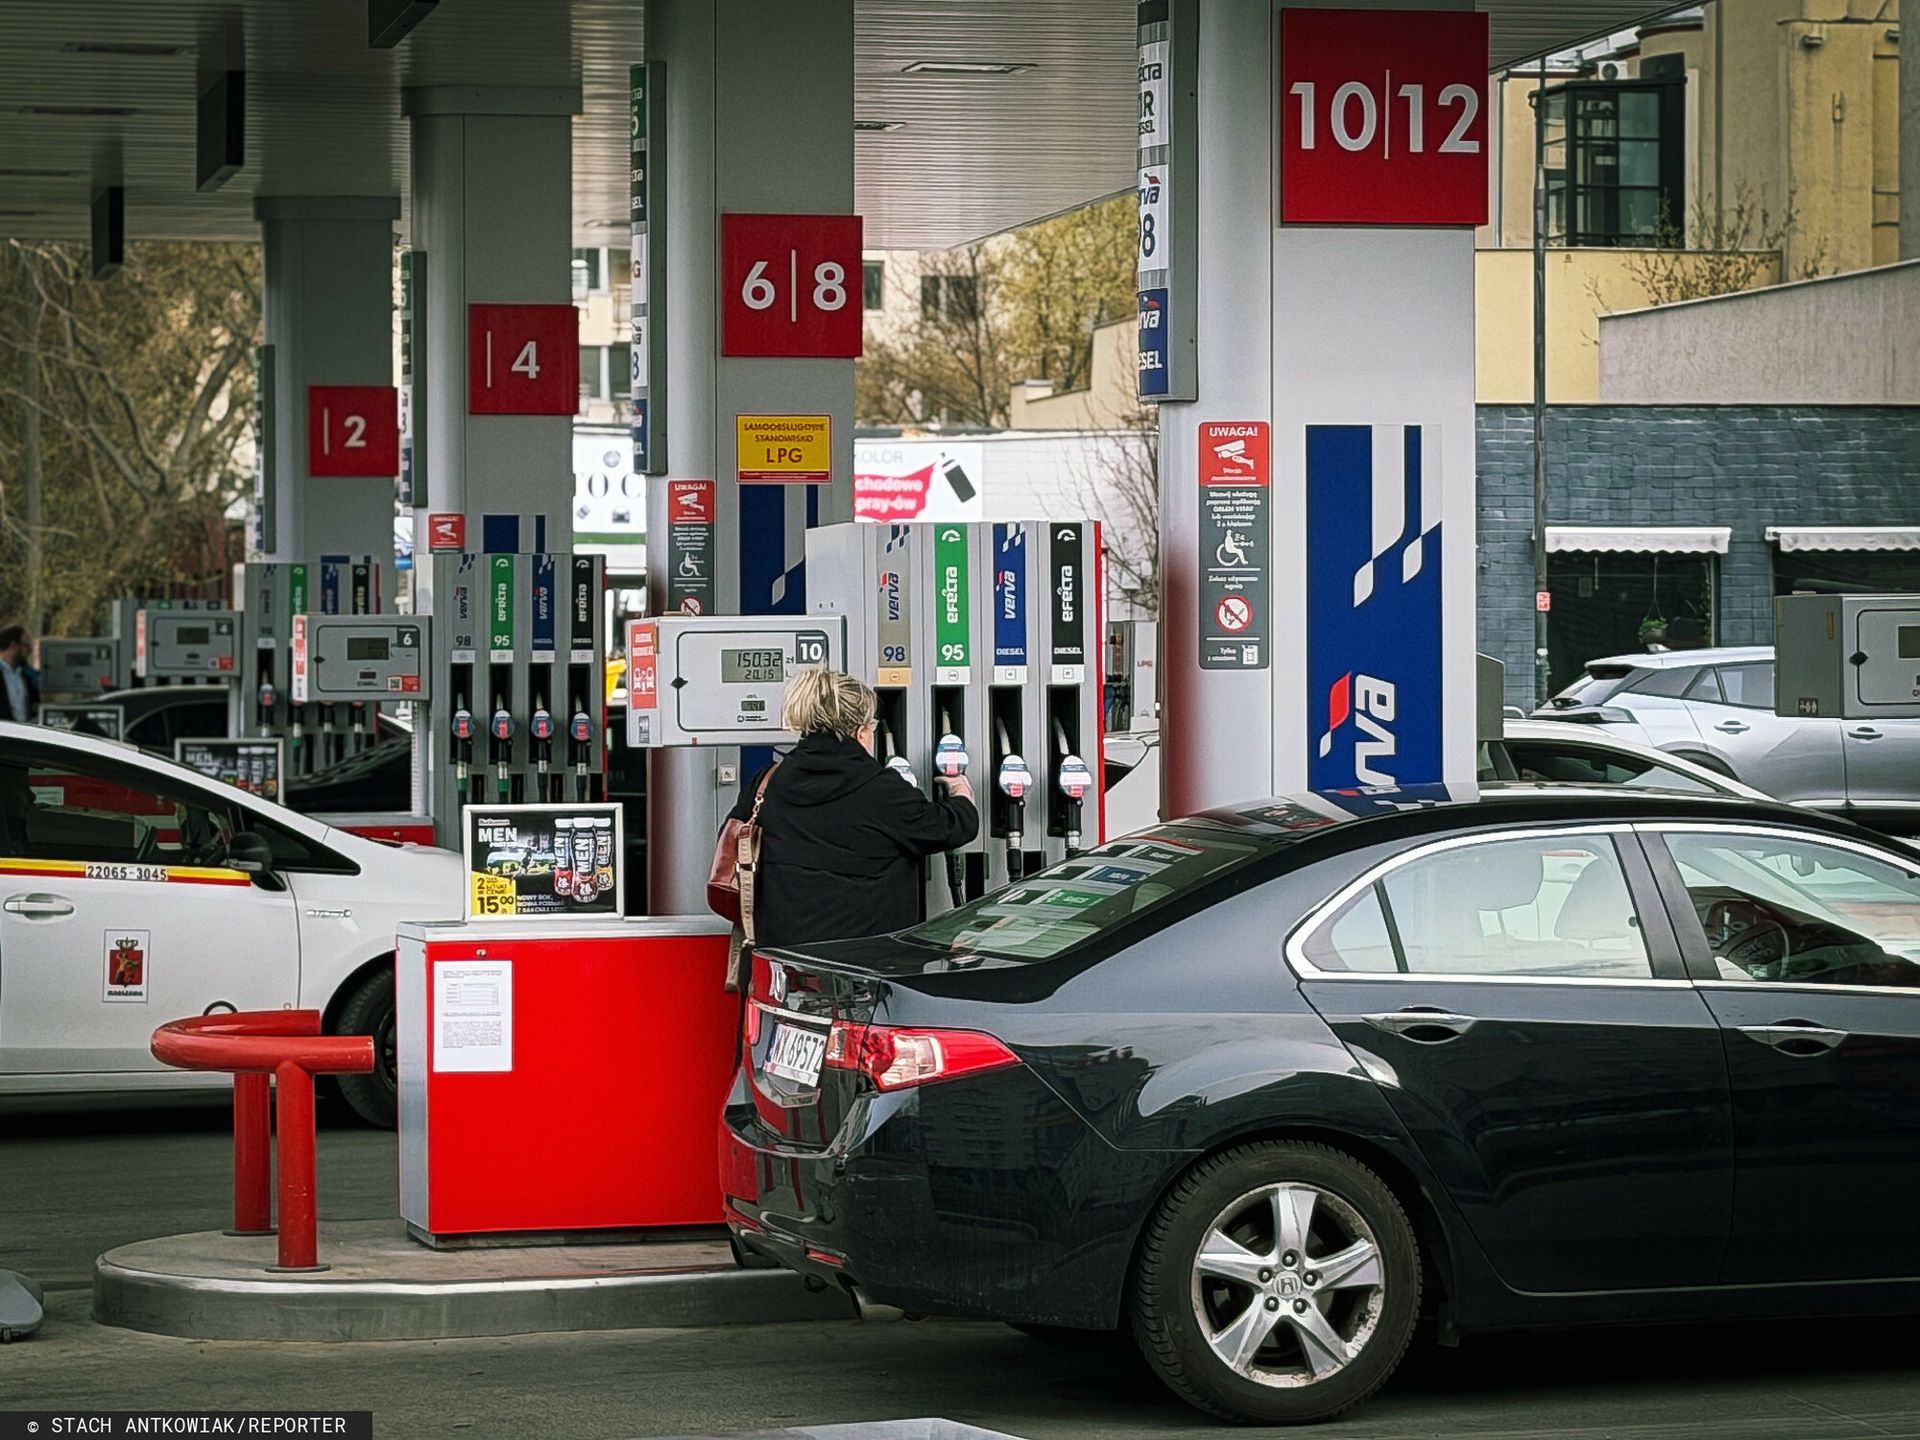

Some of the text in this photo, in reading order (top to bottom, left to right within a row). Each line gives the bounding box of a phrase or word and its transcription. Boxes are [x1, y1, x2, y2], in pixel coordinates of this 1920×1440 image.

[1289, 82, 1480, 153] 10 12
[741, 261, 847, 311] 6 8
[511, 340, 541, 379] 4
[343, 415, 367, 448] 2
[1209, 426, 1258, 437] UWAGA!
[765, 447, 803, 463] LPG
[888, 572, 900, 621] verva
[1003, 570, 1017, 619] verva
[402, 632, 413, 646] 6
[455, 635, 472, 647] 98
[494, 635, 511, 647] 95
[801, 643, 823, 661] 10
[883, 645, 906, 662] 98
[941, 643, 965, 662] 95
[996, 647, 1026, 656] DIESEL
[1053, 646, 1083, 655] DIESEL
[478, 827, 518, 843] MEN
[574, 838, 590, 872] MEN
[477, 877, 486, 890] 2
[477, 895, 500, 914] 15
